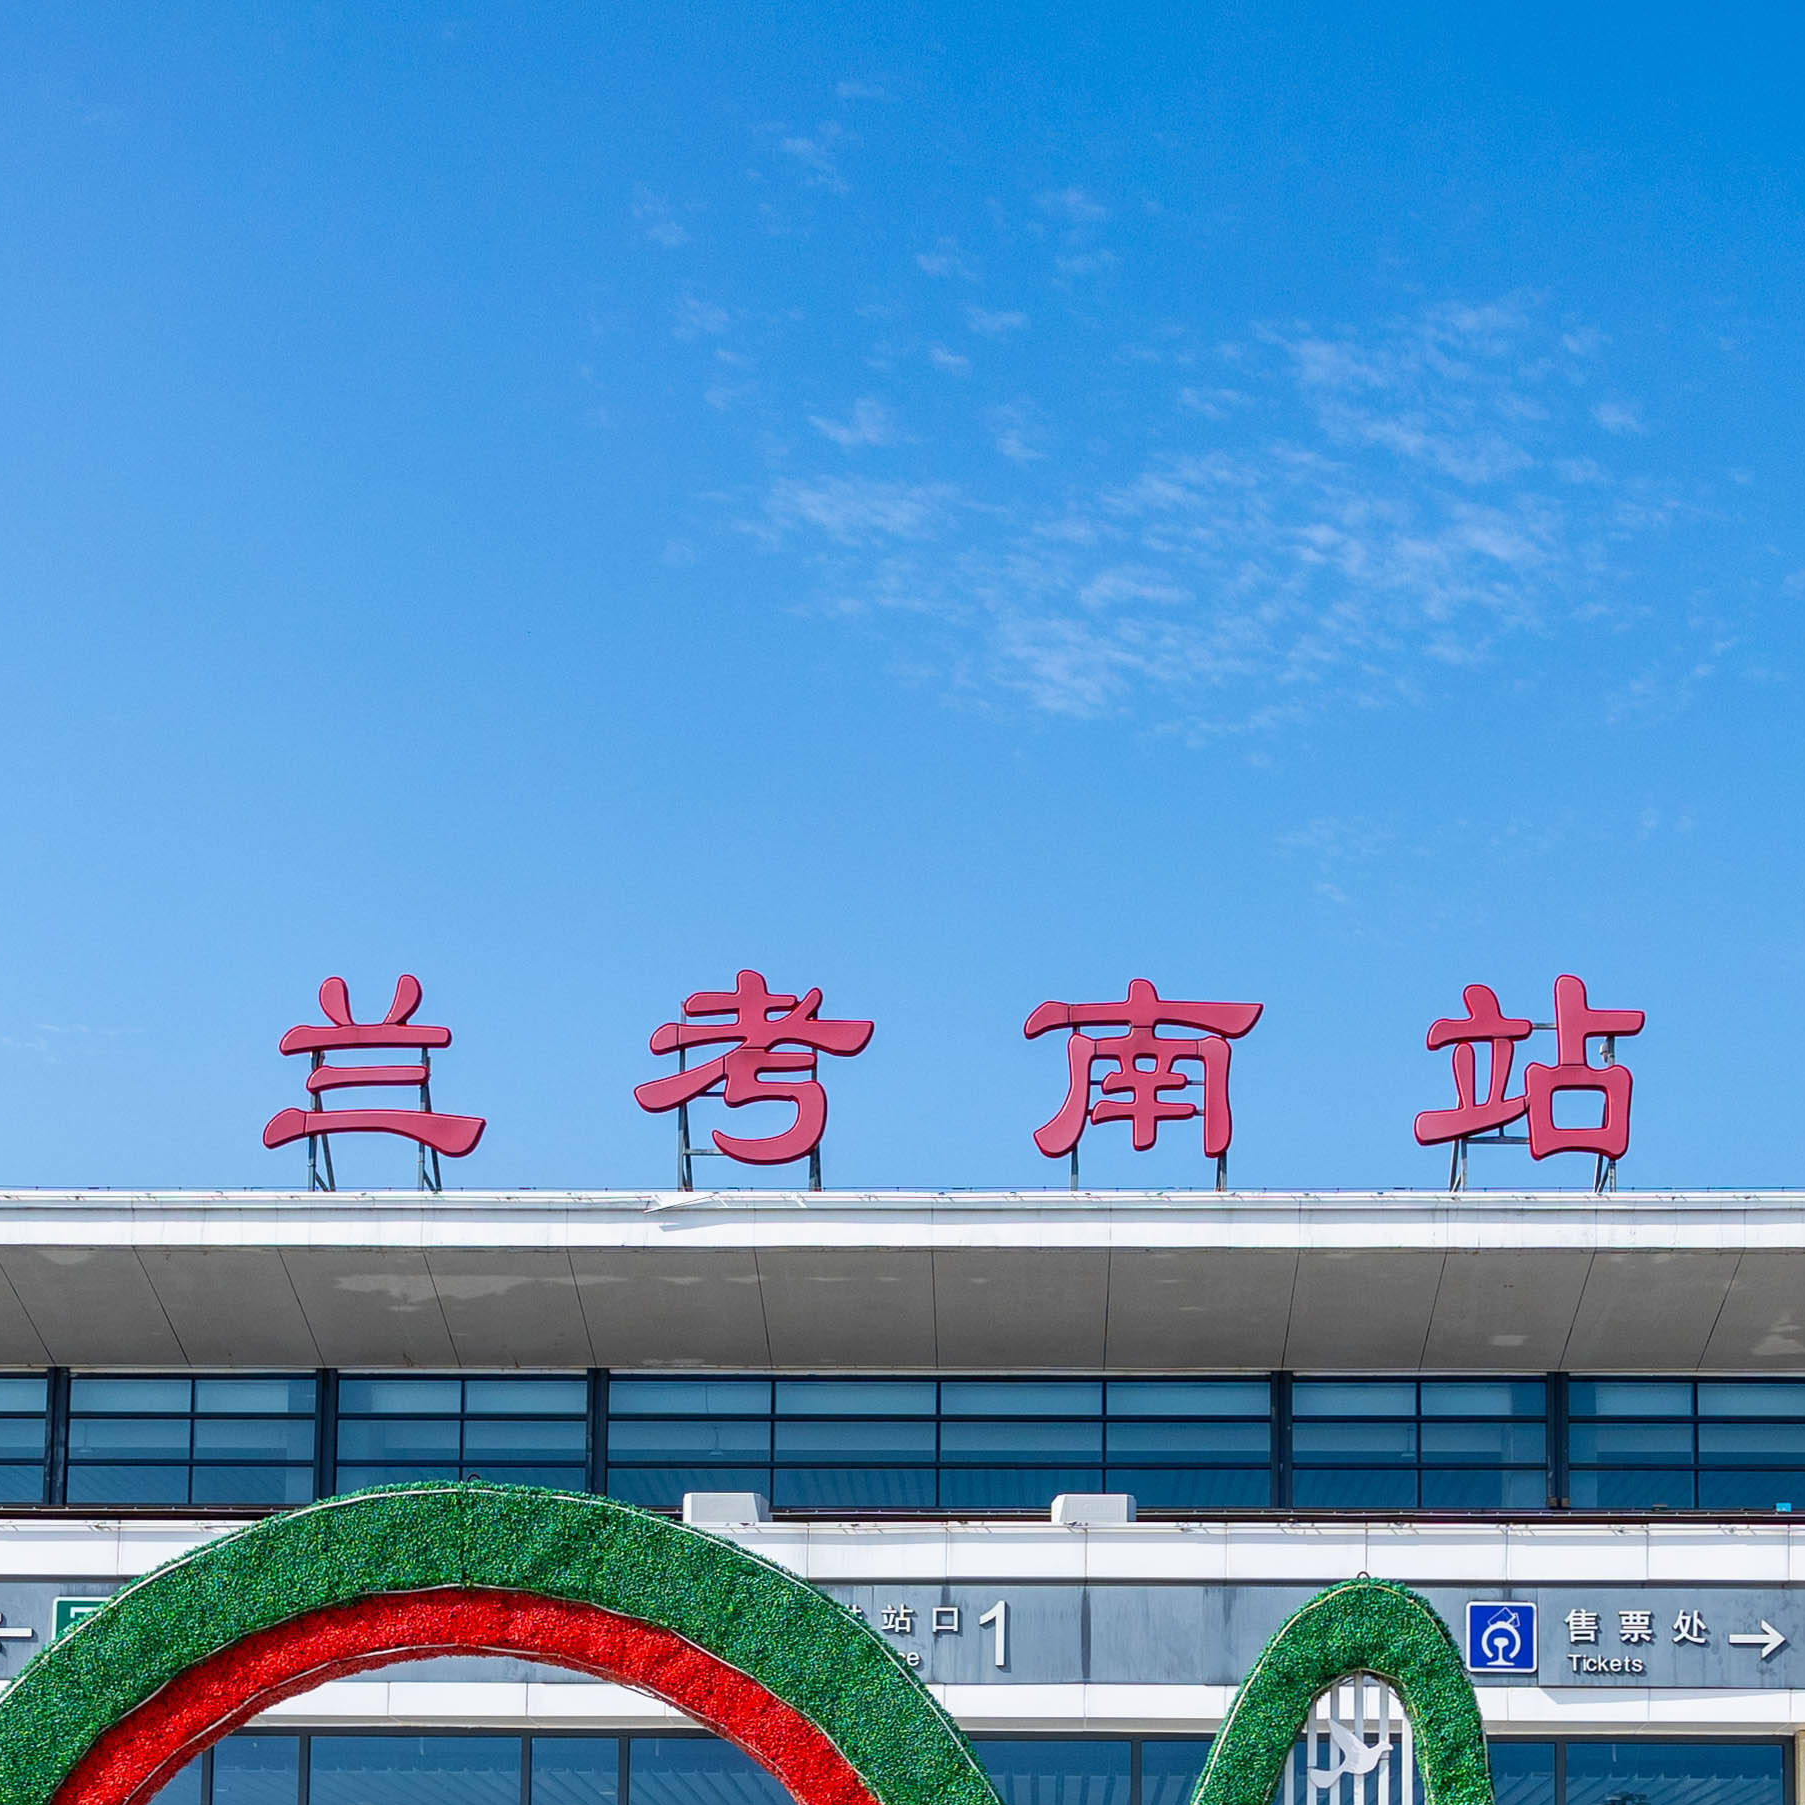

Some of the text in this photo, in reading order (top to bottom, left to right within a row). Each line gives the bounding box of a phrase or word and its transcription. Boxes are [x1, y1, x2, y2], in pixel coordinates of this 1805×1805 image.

[261, 968, 1645, 1166] 兰考南站
[1564, 1609, 1706, 1644] 售票处
[1567, 1653, 1644, 1673] Tickets
